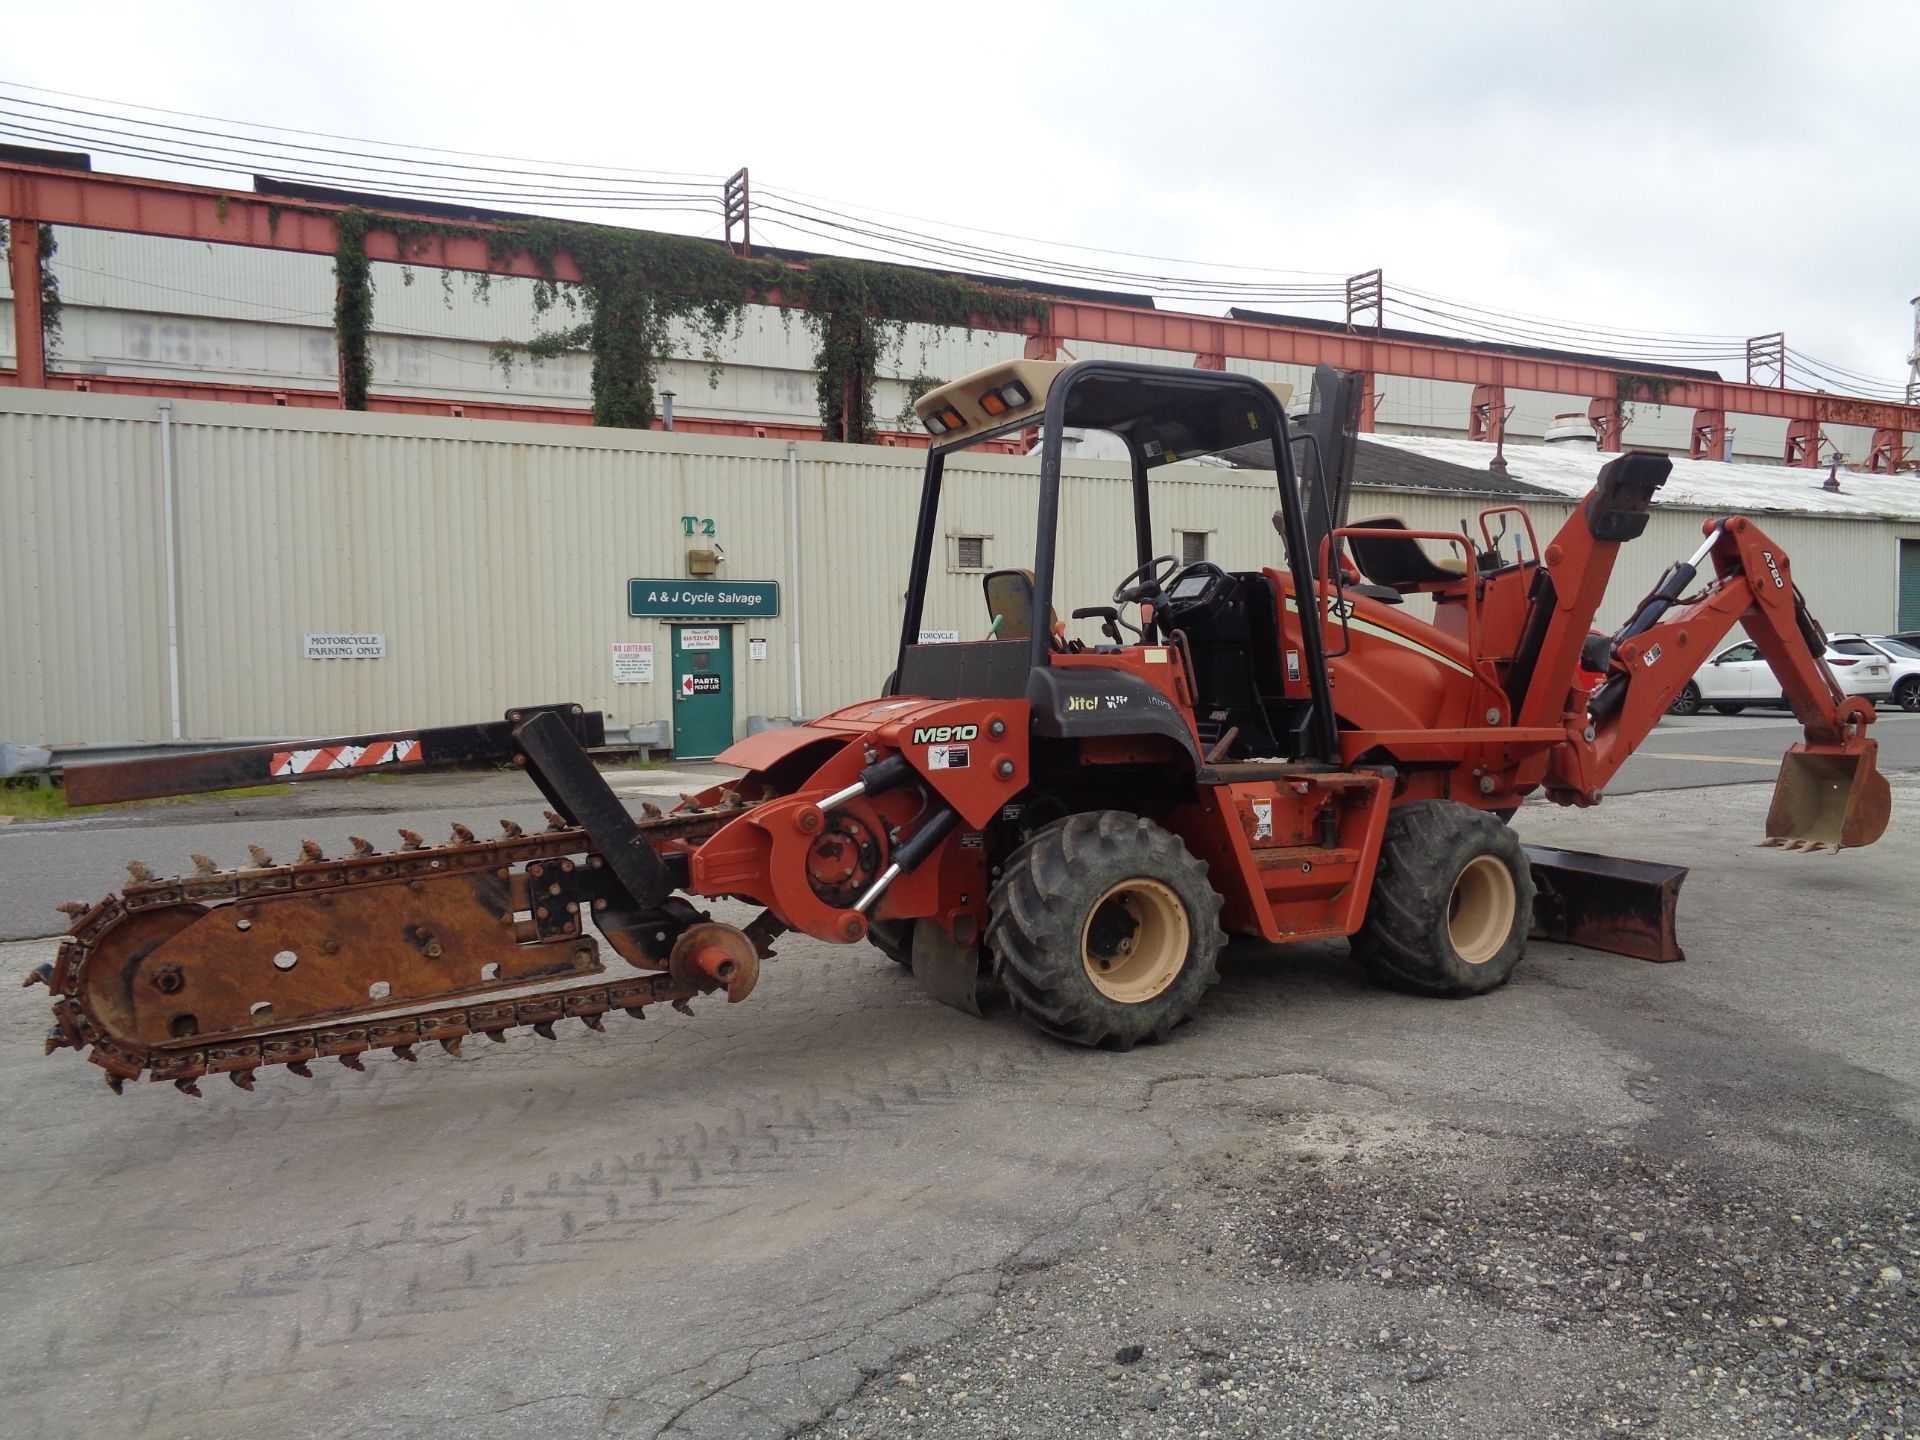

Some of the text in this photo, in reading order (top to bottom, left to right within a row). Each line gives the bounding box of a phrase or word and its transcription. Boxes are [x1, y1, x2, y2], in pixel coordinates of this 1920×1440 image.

[1762, 551, 1784, 588] A720
[648, 591, 762, 606] A & J Cycle Salvage
[311, 636, 378, 645] MOTORCYCLE
[919, 632, 954, 640] TORCYCLE
[308, 647, 382, 656] PARKING ONLY
[613, 644, 652, 653] NO LOITERING
[912, 724, 979, 744] M910
